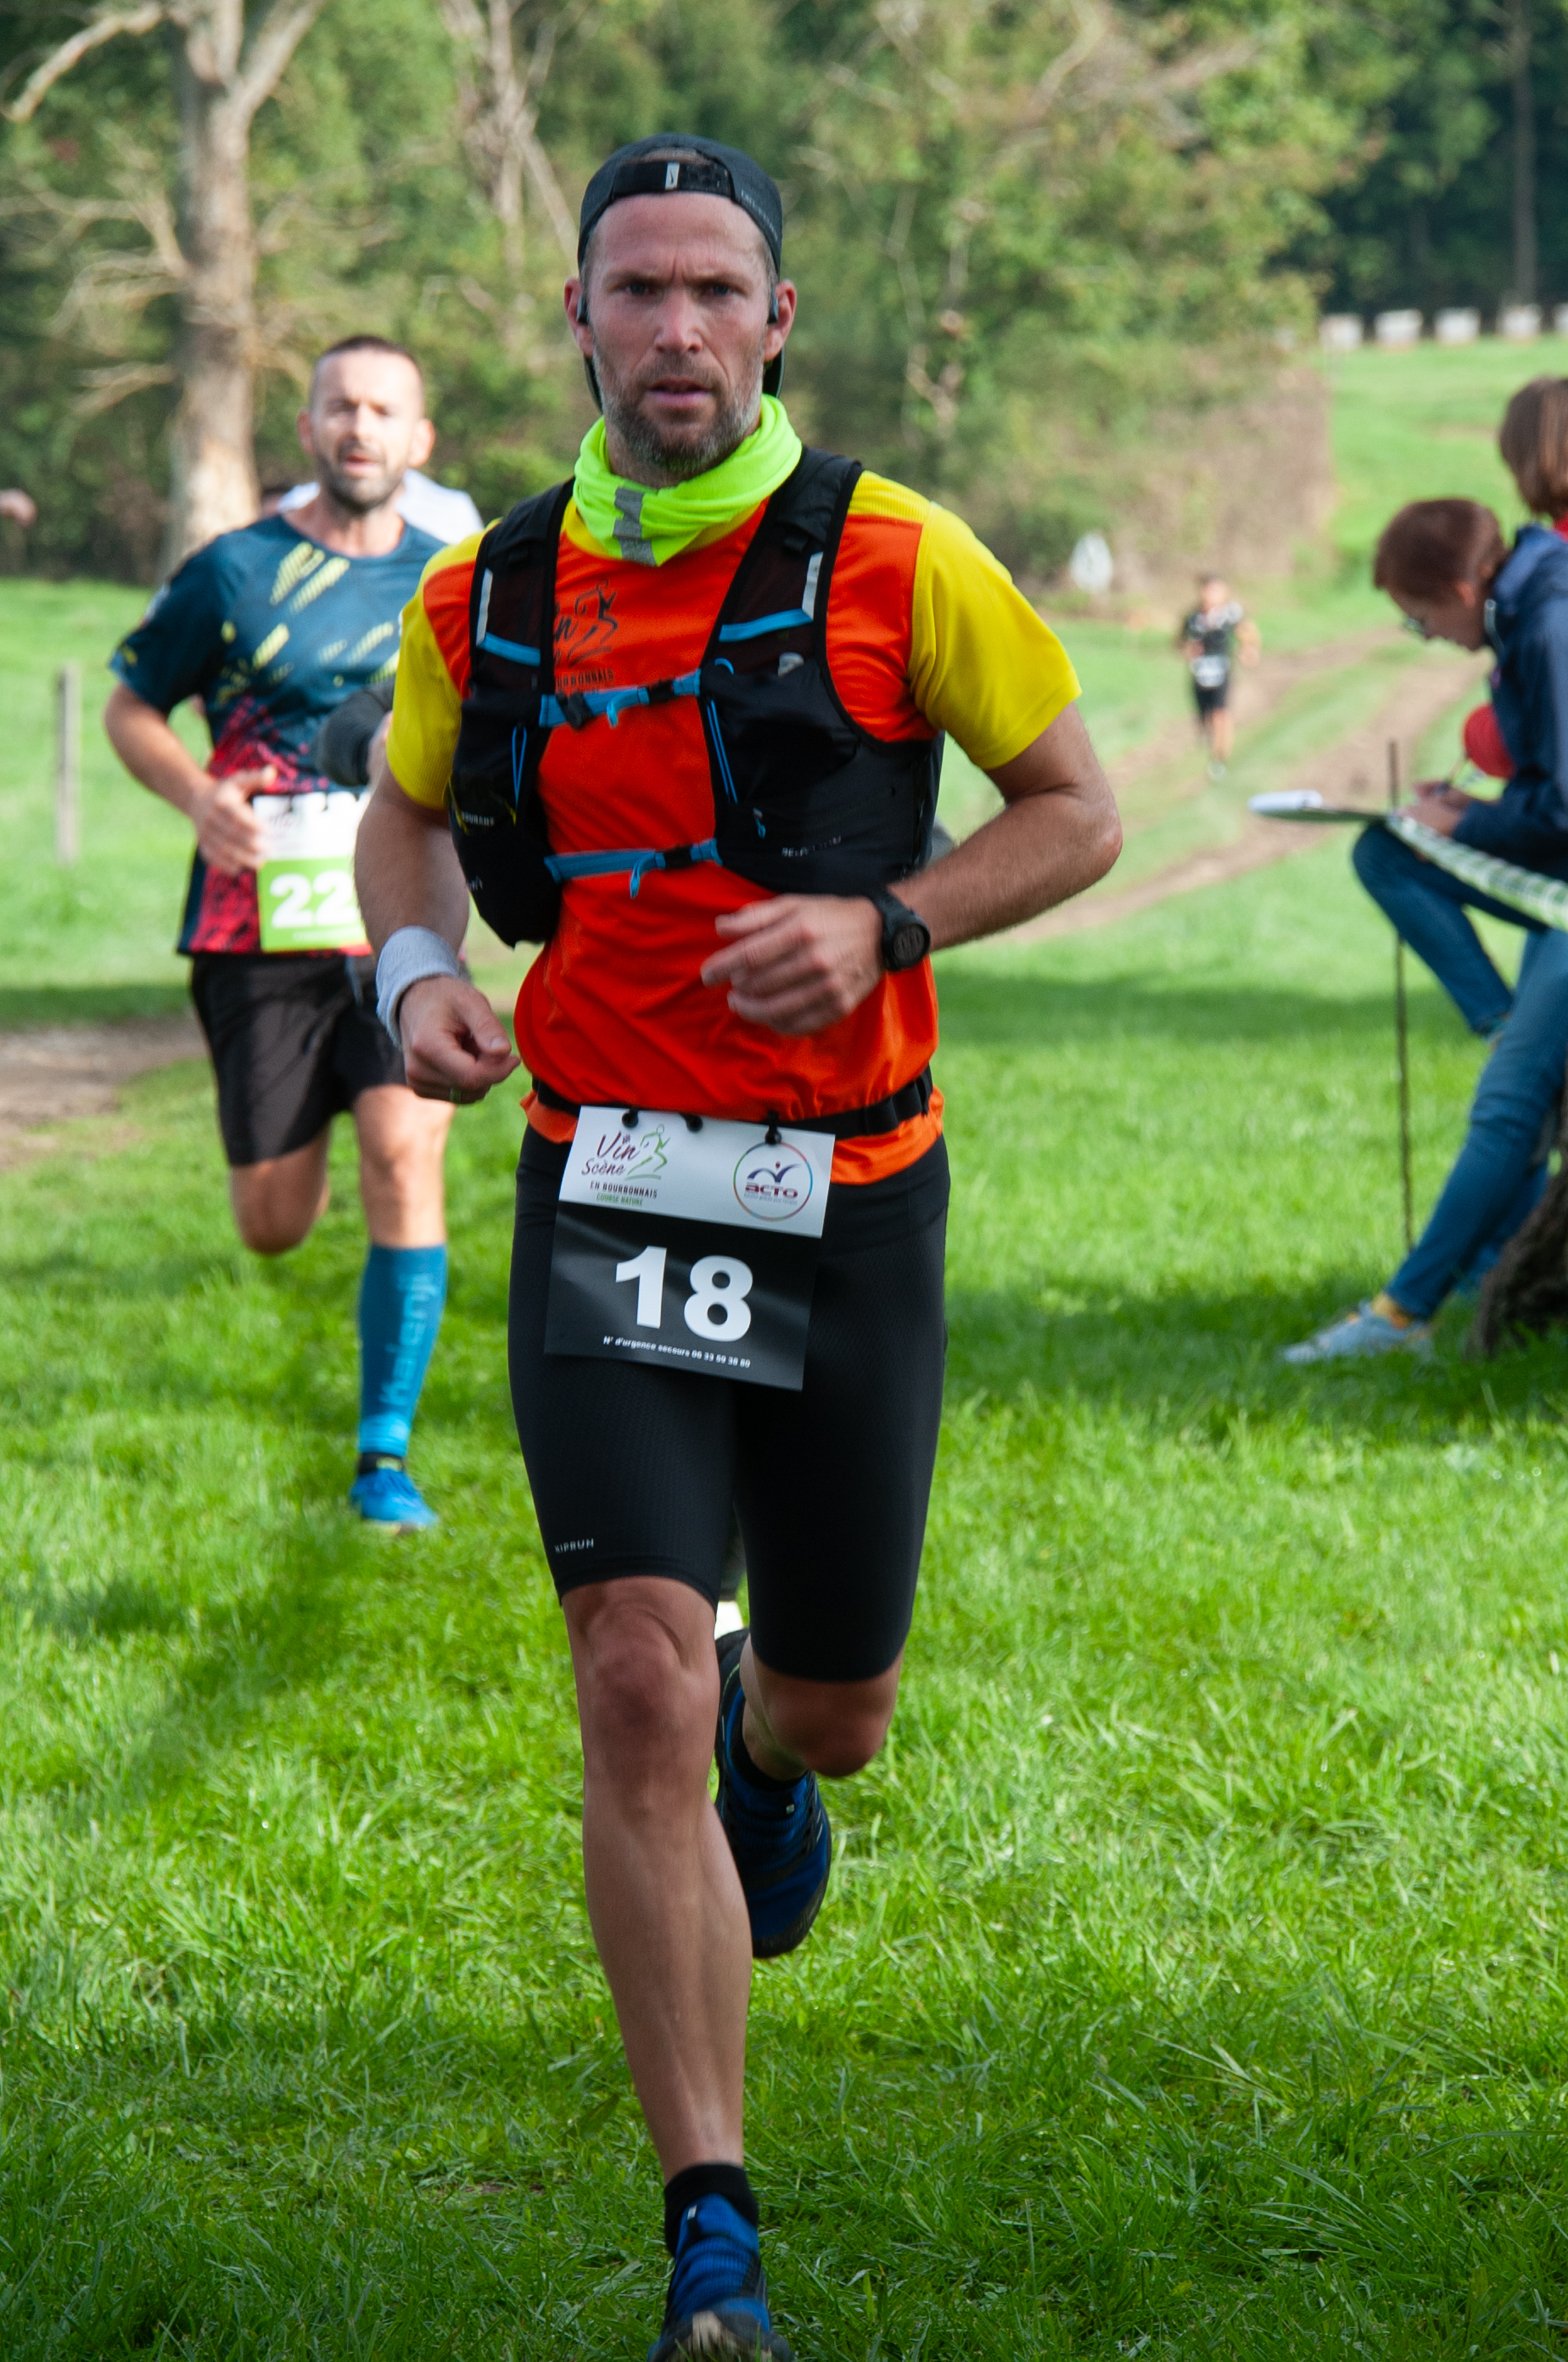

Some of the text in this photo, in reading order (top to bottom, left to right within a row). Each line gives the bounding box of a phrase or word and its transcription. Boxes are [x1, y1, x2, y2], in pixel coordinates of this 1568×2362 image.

[596, 1130, 640, 1160] Vin
[581, 1157, 625, 1176] Scène
[615, 1245, 753, 1342] 18
